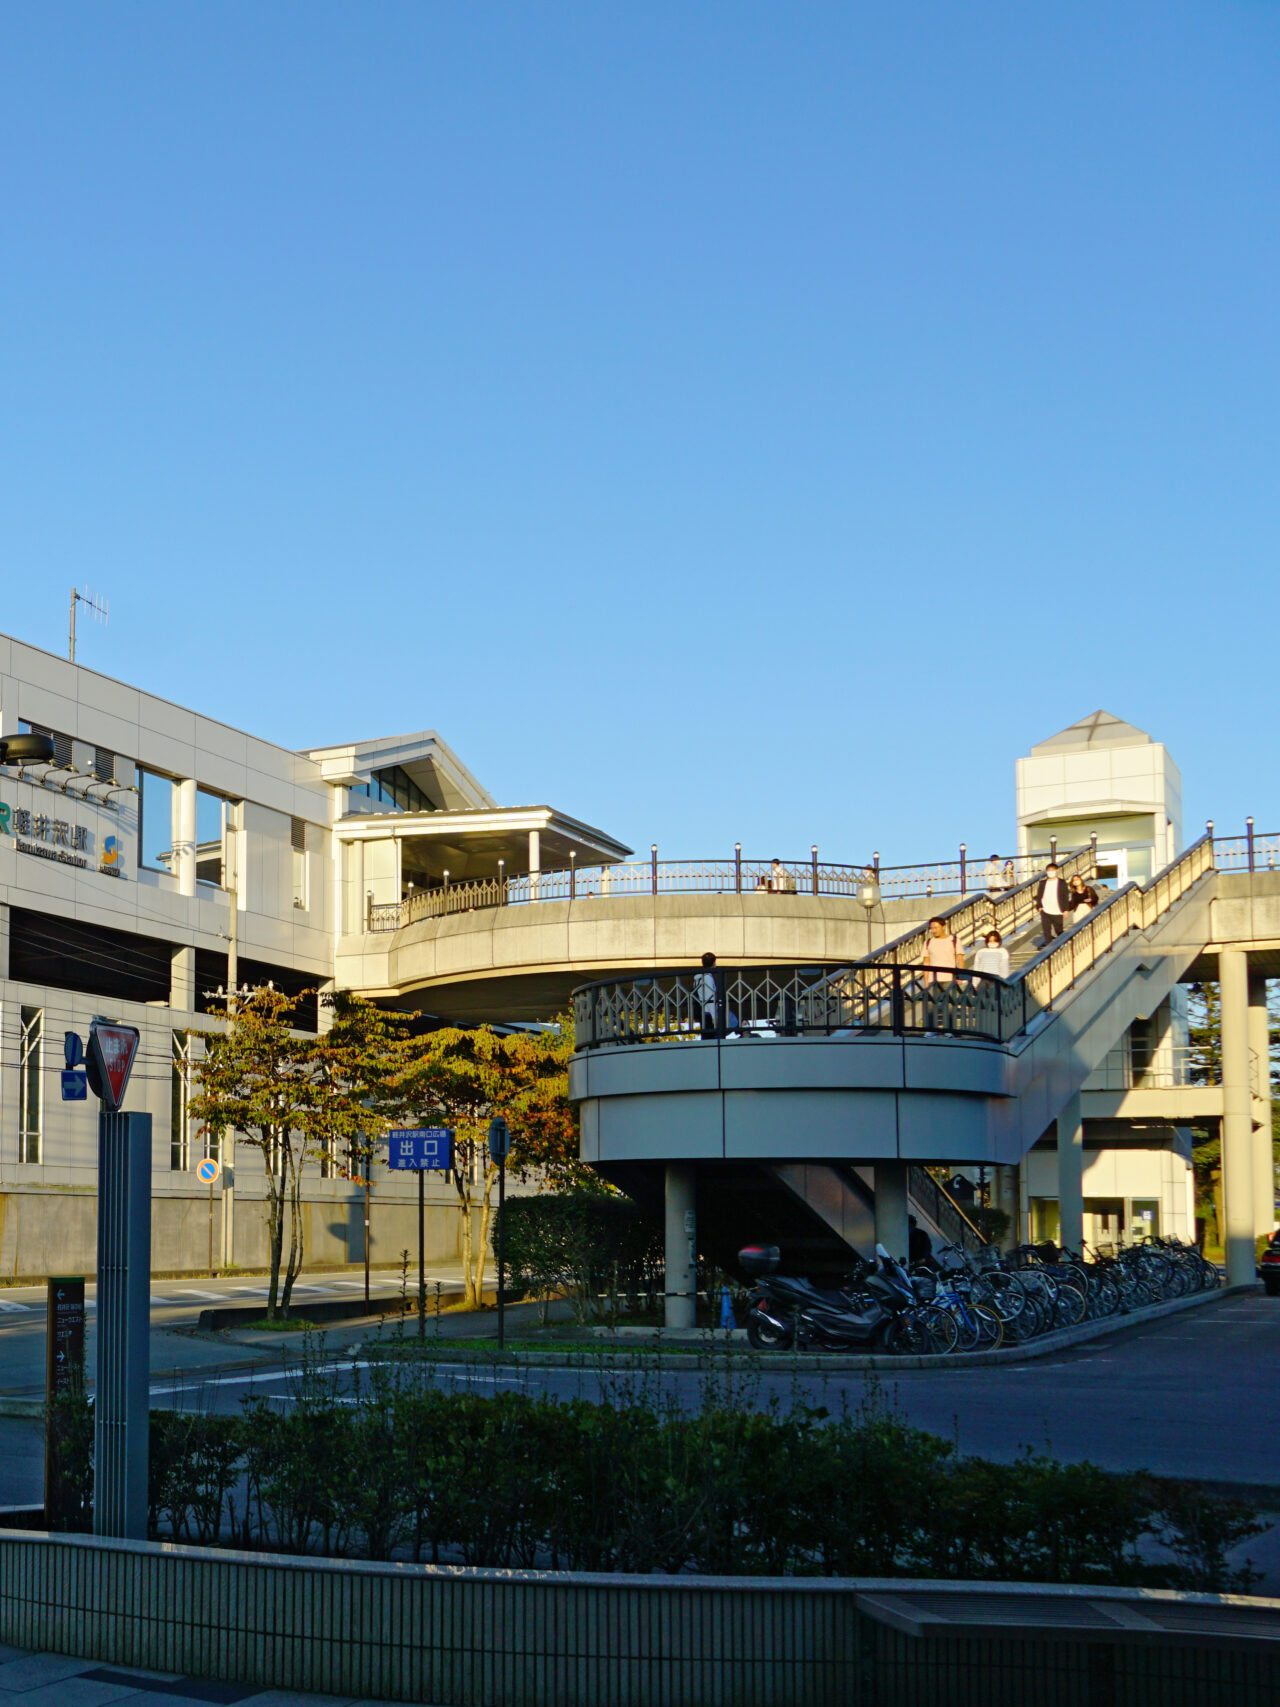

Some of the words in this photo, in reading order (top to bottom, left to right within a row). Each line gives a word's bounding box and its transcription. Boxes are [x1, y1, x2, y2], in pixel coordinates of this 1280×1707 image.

[13, 807, 88, 850] 軽井沢駅
[108, 1058, 126, 1073] STOP
[400, 1140, 438, 1156] 出口
[398, 1158, 440, 1167] 進入禁止
